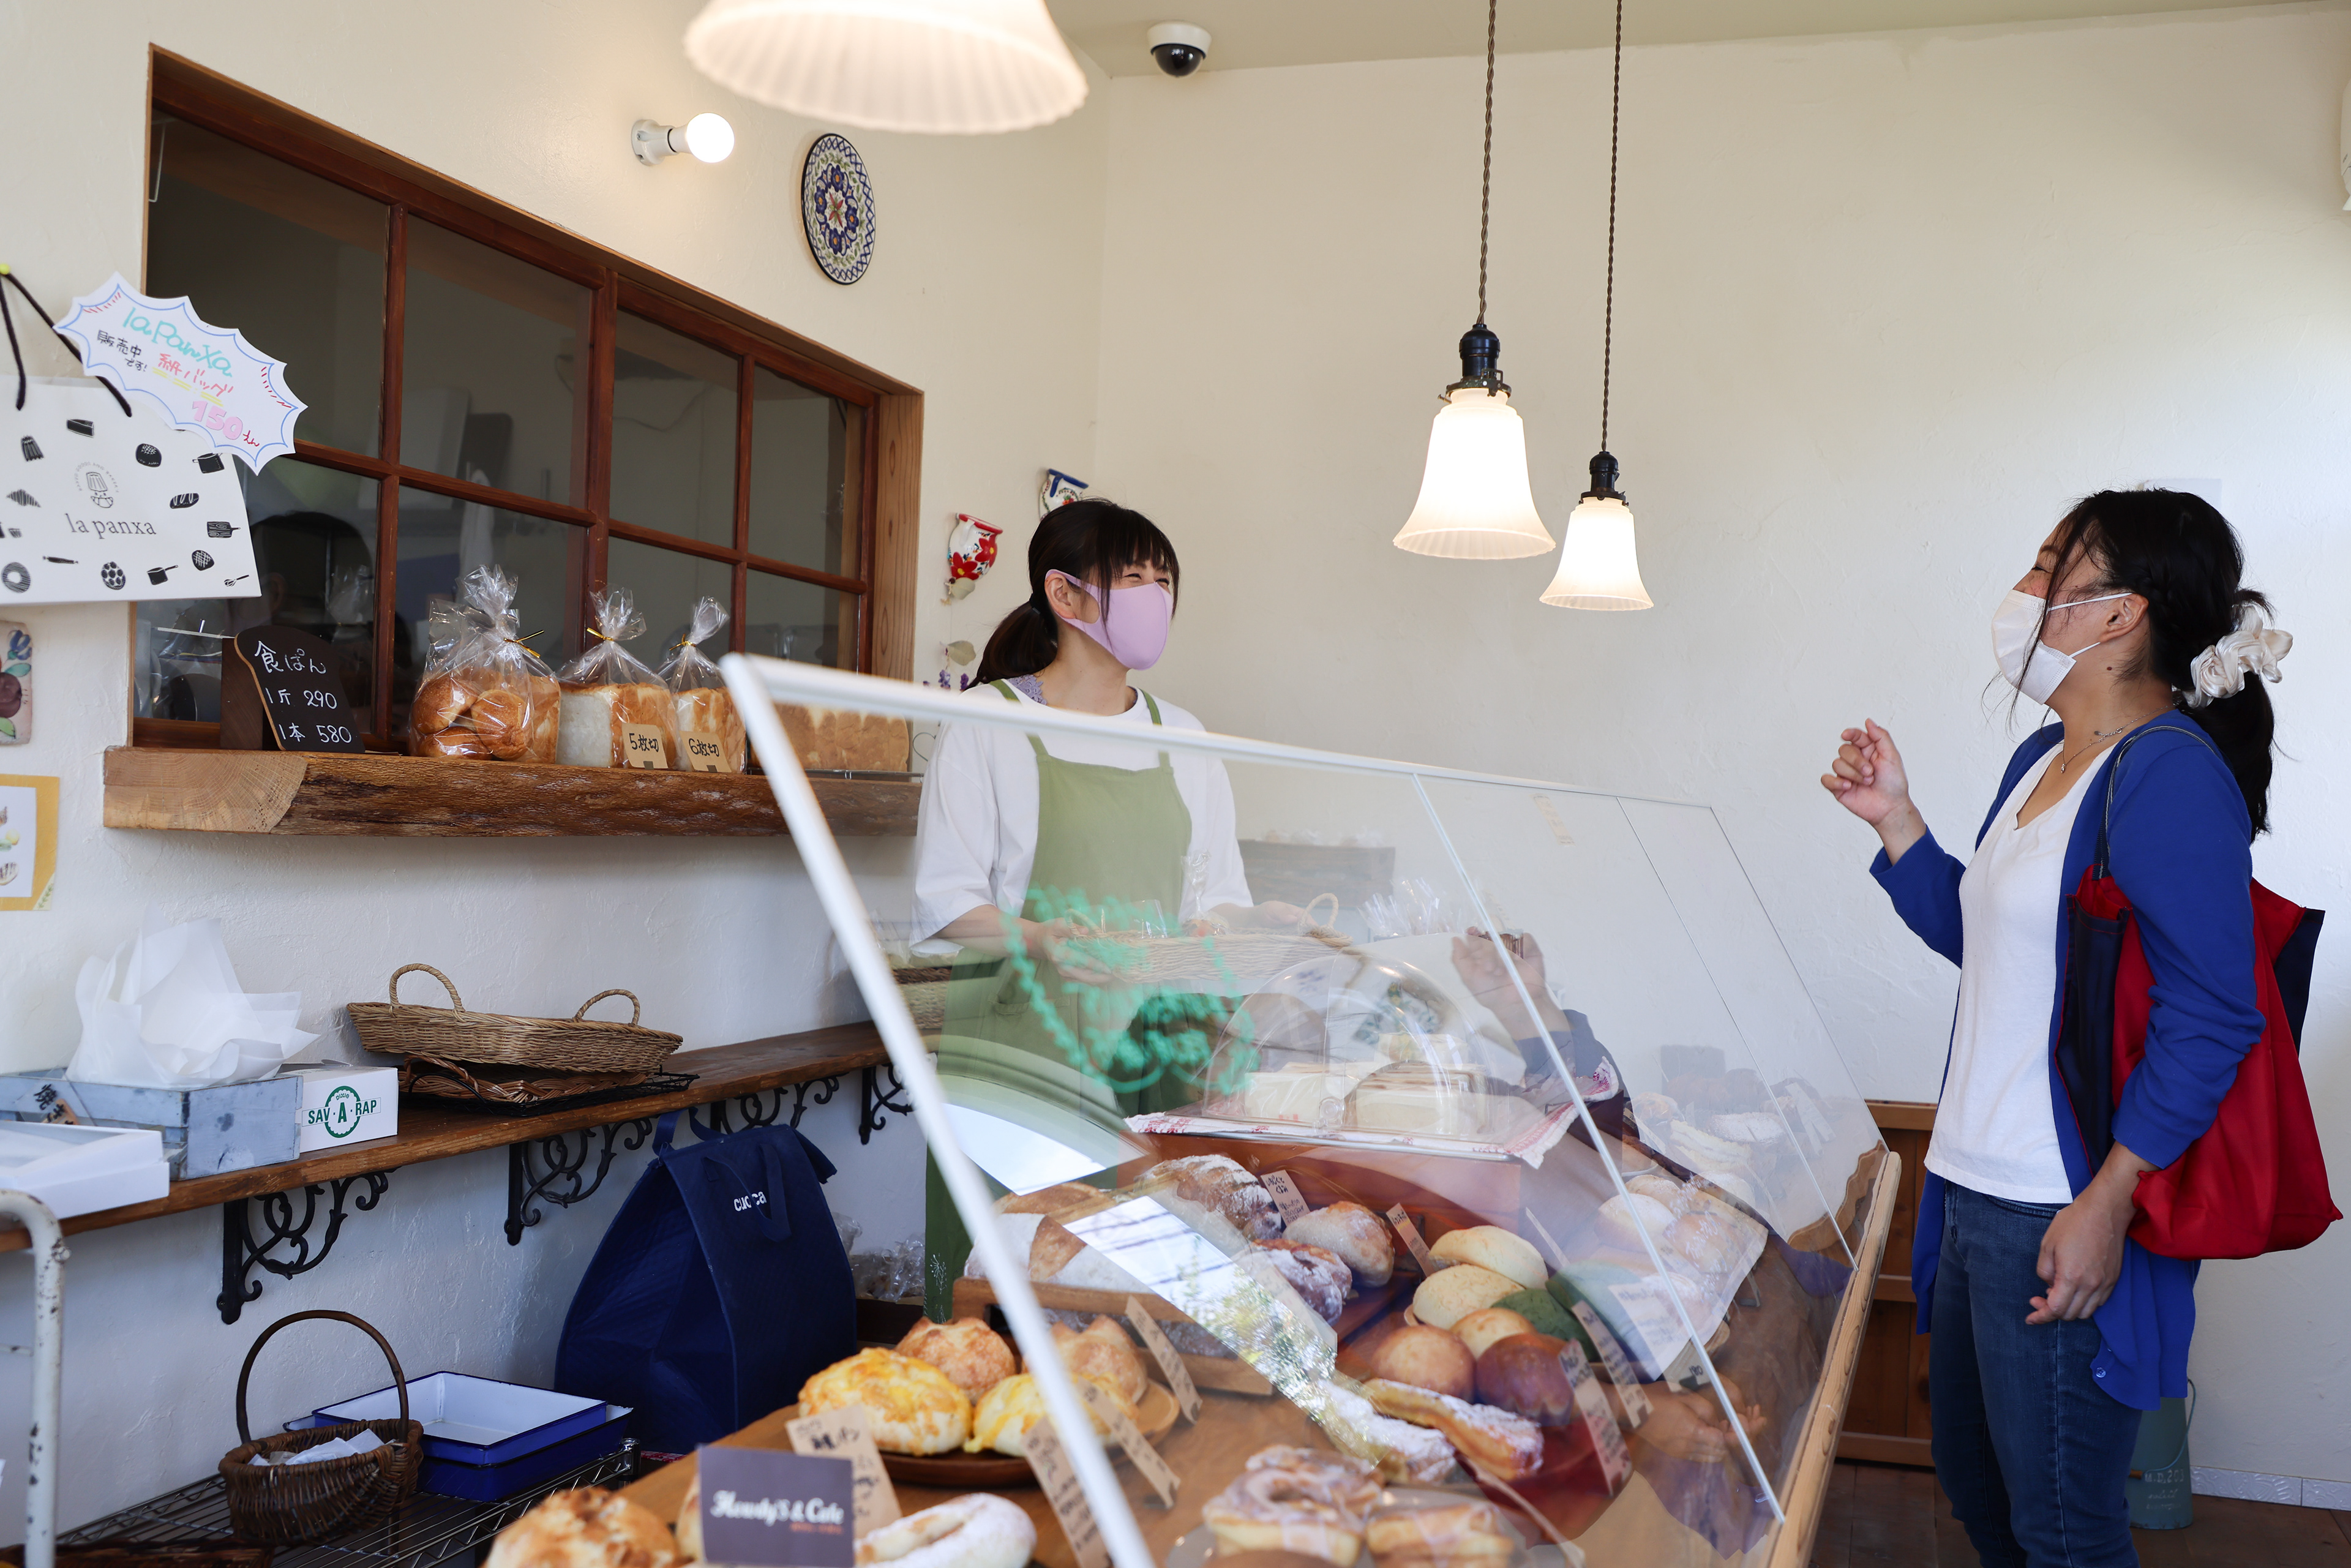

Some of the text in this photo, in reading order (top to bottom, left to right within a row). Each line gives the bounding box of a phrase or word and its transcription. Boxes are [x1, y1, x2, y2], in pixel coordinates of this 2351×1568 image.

[97, 329, 141, 358] 販売中
[158, 353, 234, 397] 紙バッグ
[65, 513, 156, 539] la panxa
[255, 640, 326, 674] 食ぱん
[303, 690, 337, 710] 290
[316, 725, 352, 743] 580
[629, 733, 659, 752] 5枚切
[688, 738, 719, 757] 6枚切
